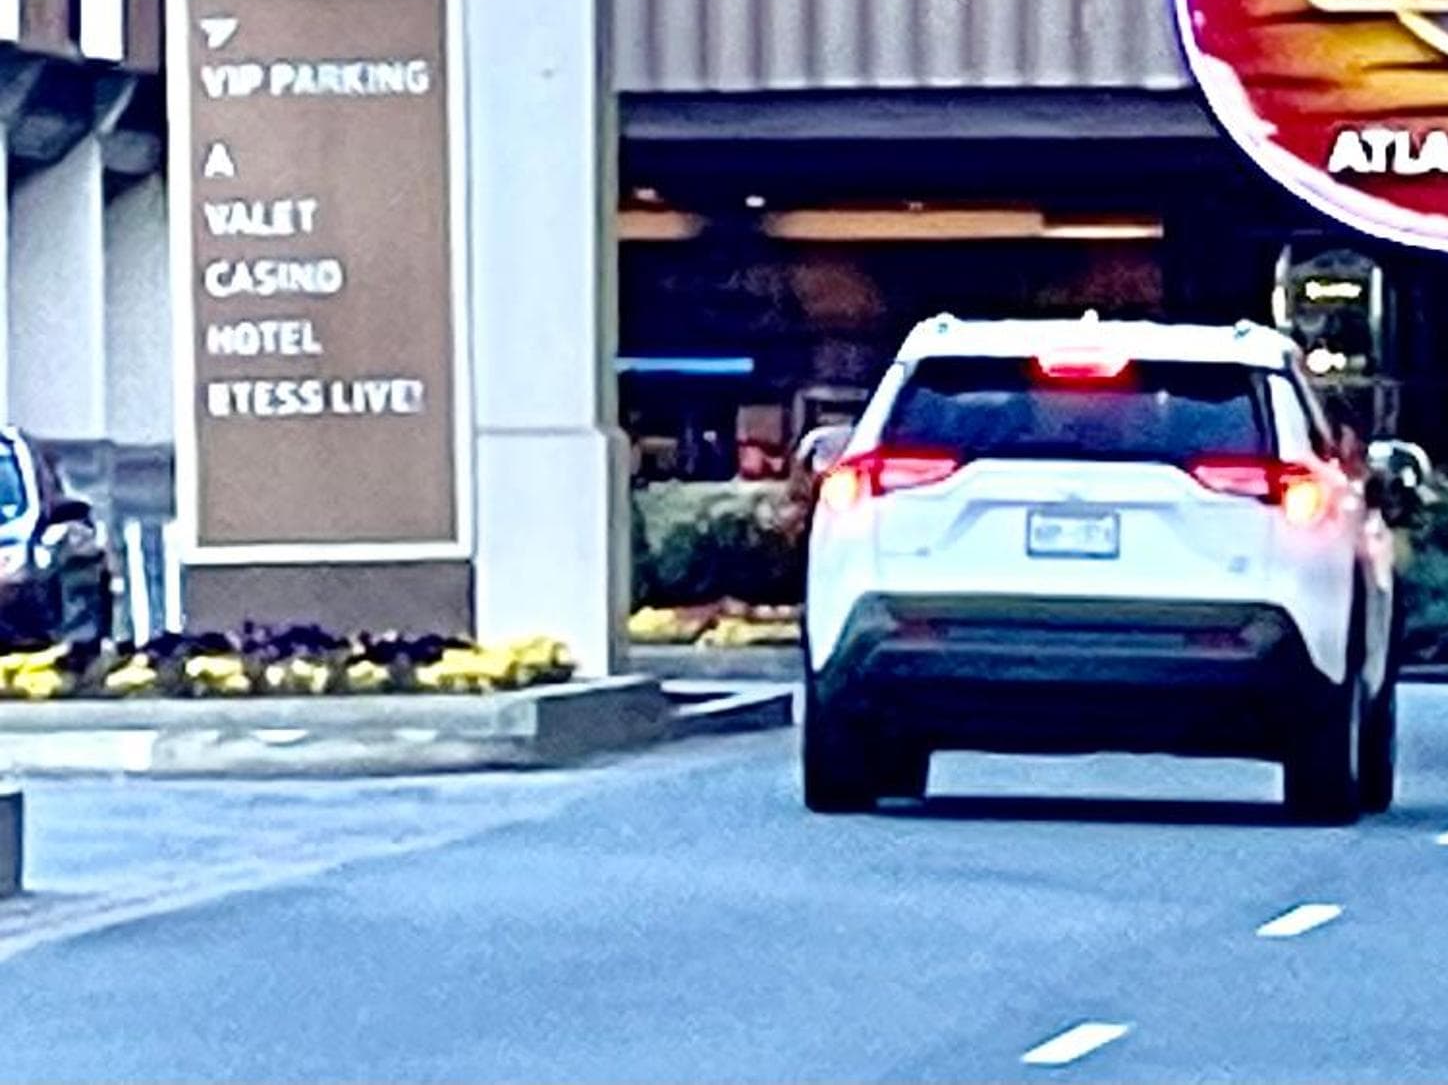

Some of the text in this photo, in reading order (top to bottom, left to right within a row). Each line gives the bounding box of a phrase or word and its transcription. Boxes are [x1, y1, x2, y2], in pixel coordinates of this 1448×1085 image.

[200, 61, 431, 98] VIP PARKING
[204, 198, 318, 236] VALET
[204, 259, 344, 298] CASINO
[207, 321, 323, 357] HOTEL
